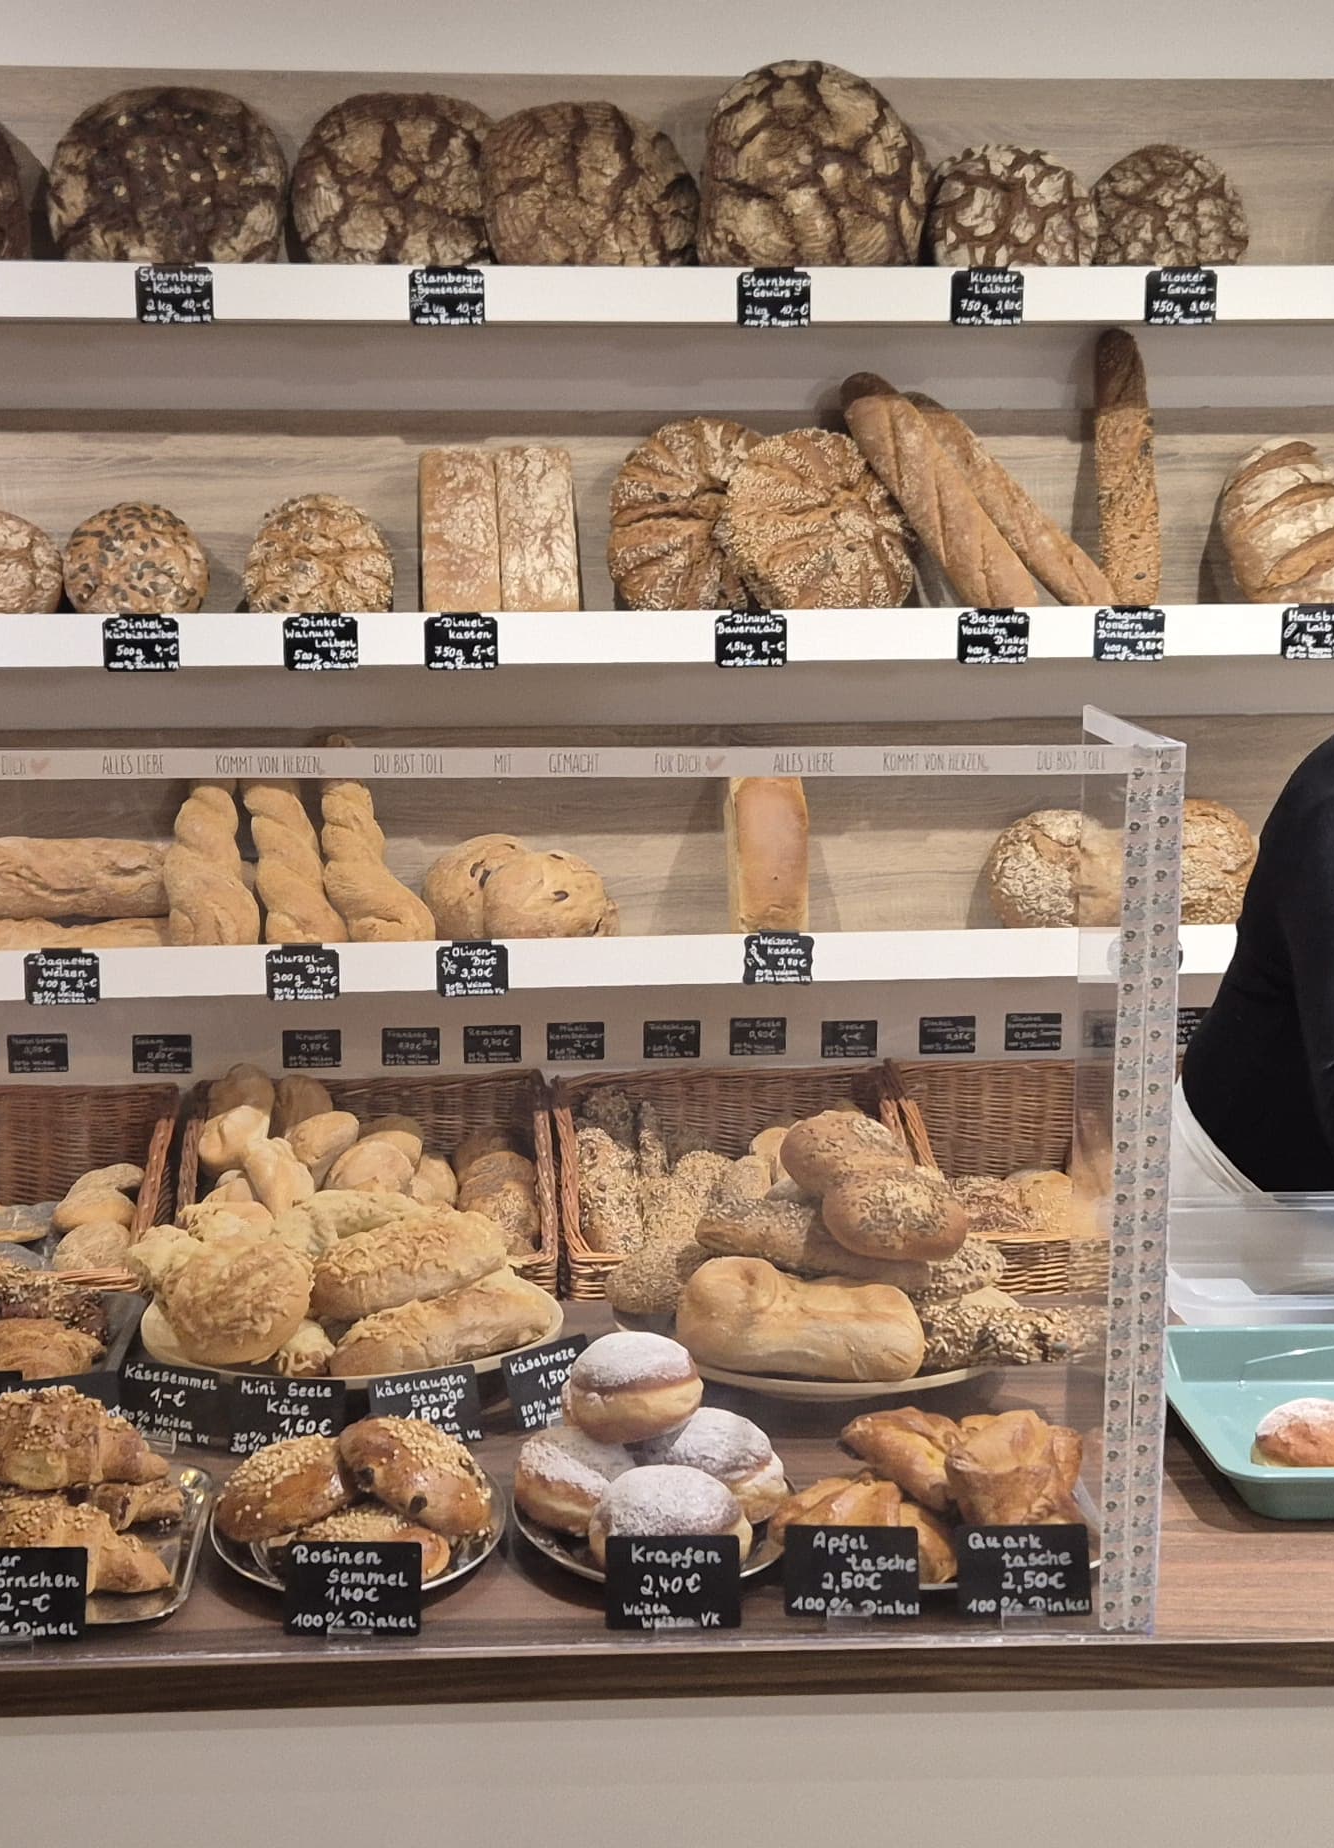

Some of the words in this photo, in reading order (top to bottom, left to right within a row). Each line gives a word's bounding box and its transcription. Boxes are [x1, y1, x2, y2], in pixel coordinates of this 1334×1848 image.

[139, 268, 213, 286] Starnberger
[414, 272, 485, 286] Starnberger
[742, 275, 811, 291] Starnberger
[101, 754, 133, 775] ALLES
[137, 754, 164, 775] LIEBE
[215, 754, 253, 774] KOMMT
[257, 754, 279, 774] VON
[374, 753, 389, 774] DU
[394, 753, 415, 774] BIST
[419, 753, 443, 774] TOLL
[494, 753, 513, 773] MIT
[548, 752, 601, 774] GEMACHT
[772, 753, 803, 772] ALLES
[808, 753, 835, 772] LIEBE
[882, 752, 919, 771] KOMMT
[923, 752, 943, 771] VON
[1035, 750, 1052, 770] DU
[1056, 750, 1076, 770] BIST
[1082, 750, 1106, 769] TOLL
[306, 964, 334, 974] Brot
[471, 956, 497, 966] Brot
[42, 968, 87, 978] Weizen
[124, 1364, 218, 1391] Käsesemmel
[241, 1380, 277, 1396] Mini
[287, 1382, 333, 1398] Seele
[267, 1399, 311, 1417] Käse
[812, 1530, 868, 1555] Apfel
[968, 1532, 1042, 1550] Quark
[291, 1544, 382, 1565] Rosinen
[630, 1543, 722, 1569] Krapfen
[846, 1553, 916, 1572] tasche
[1001, 1550, 1072, 1568] tasche
[327, 1568, 409, 1587] Semmel
[640, 1572, 702, 1598] 2,40€
[821, 1572, 882, 1594] 2,50€
[1001, 1570, 1066, 1594] 2,50€
[325, 1586, 380, 1606] 1,40€
[1028, 1595, 1089, 1612] Dinkel
[623, 1601, 671, 1616] Weizen
[860, 1599, 920, 1616] Dinkel
[12, 1620, 79, 1637] Dinkel
[349, 1610, 417, 1629] Dinkel
[700, 1611, 721, 1627] VK
